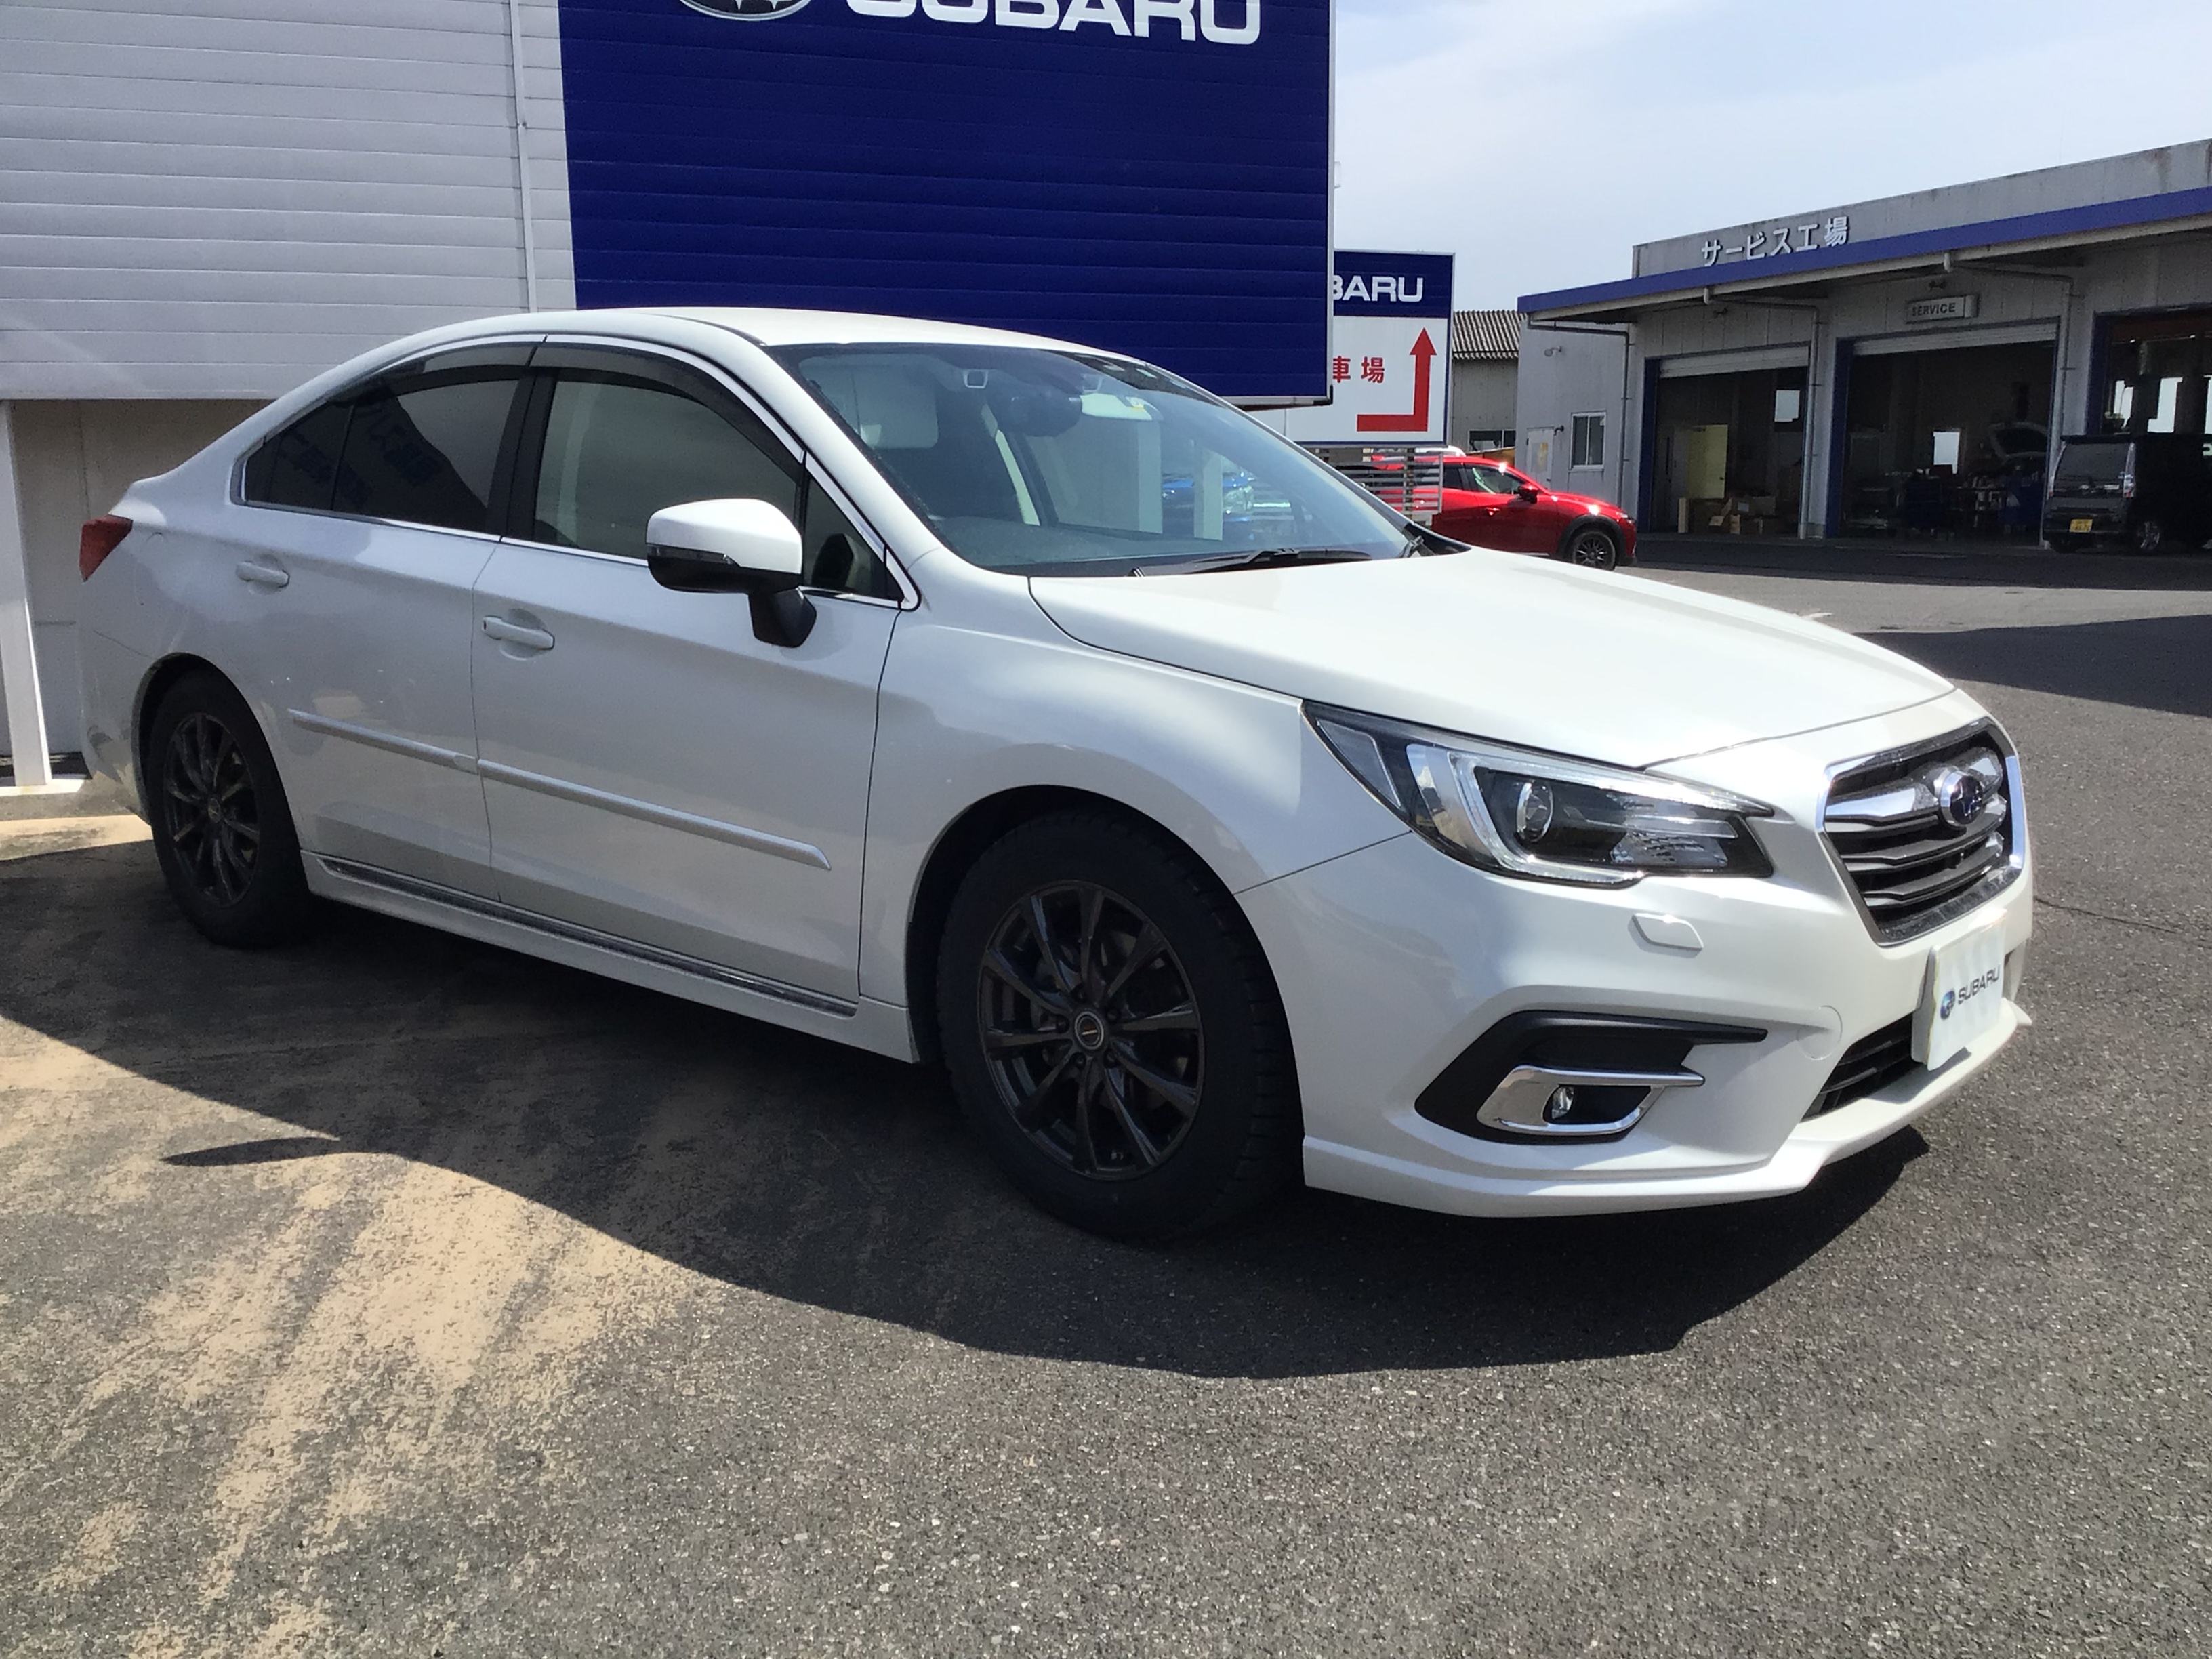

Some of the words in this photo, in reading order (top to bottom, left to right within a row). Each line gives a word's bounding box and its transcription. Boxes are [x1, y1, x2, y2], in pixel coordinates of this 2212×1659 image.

[1702, 216, 1849, 266] サービス工場
[1912, 302, 1956, 317] SERVICE
[1958, 964, 2000, 1004] SUBARU
